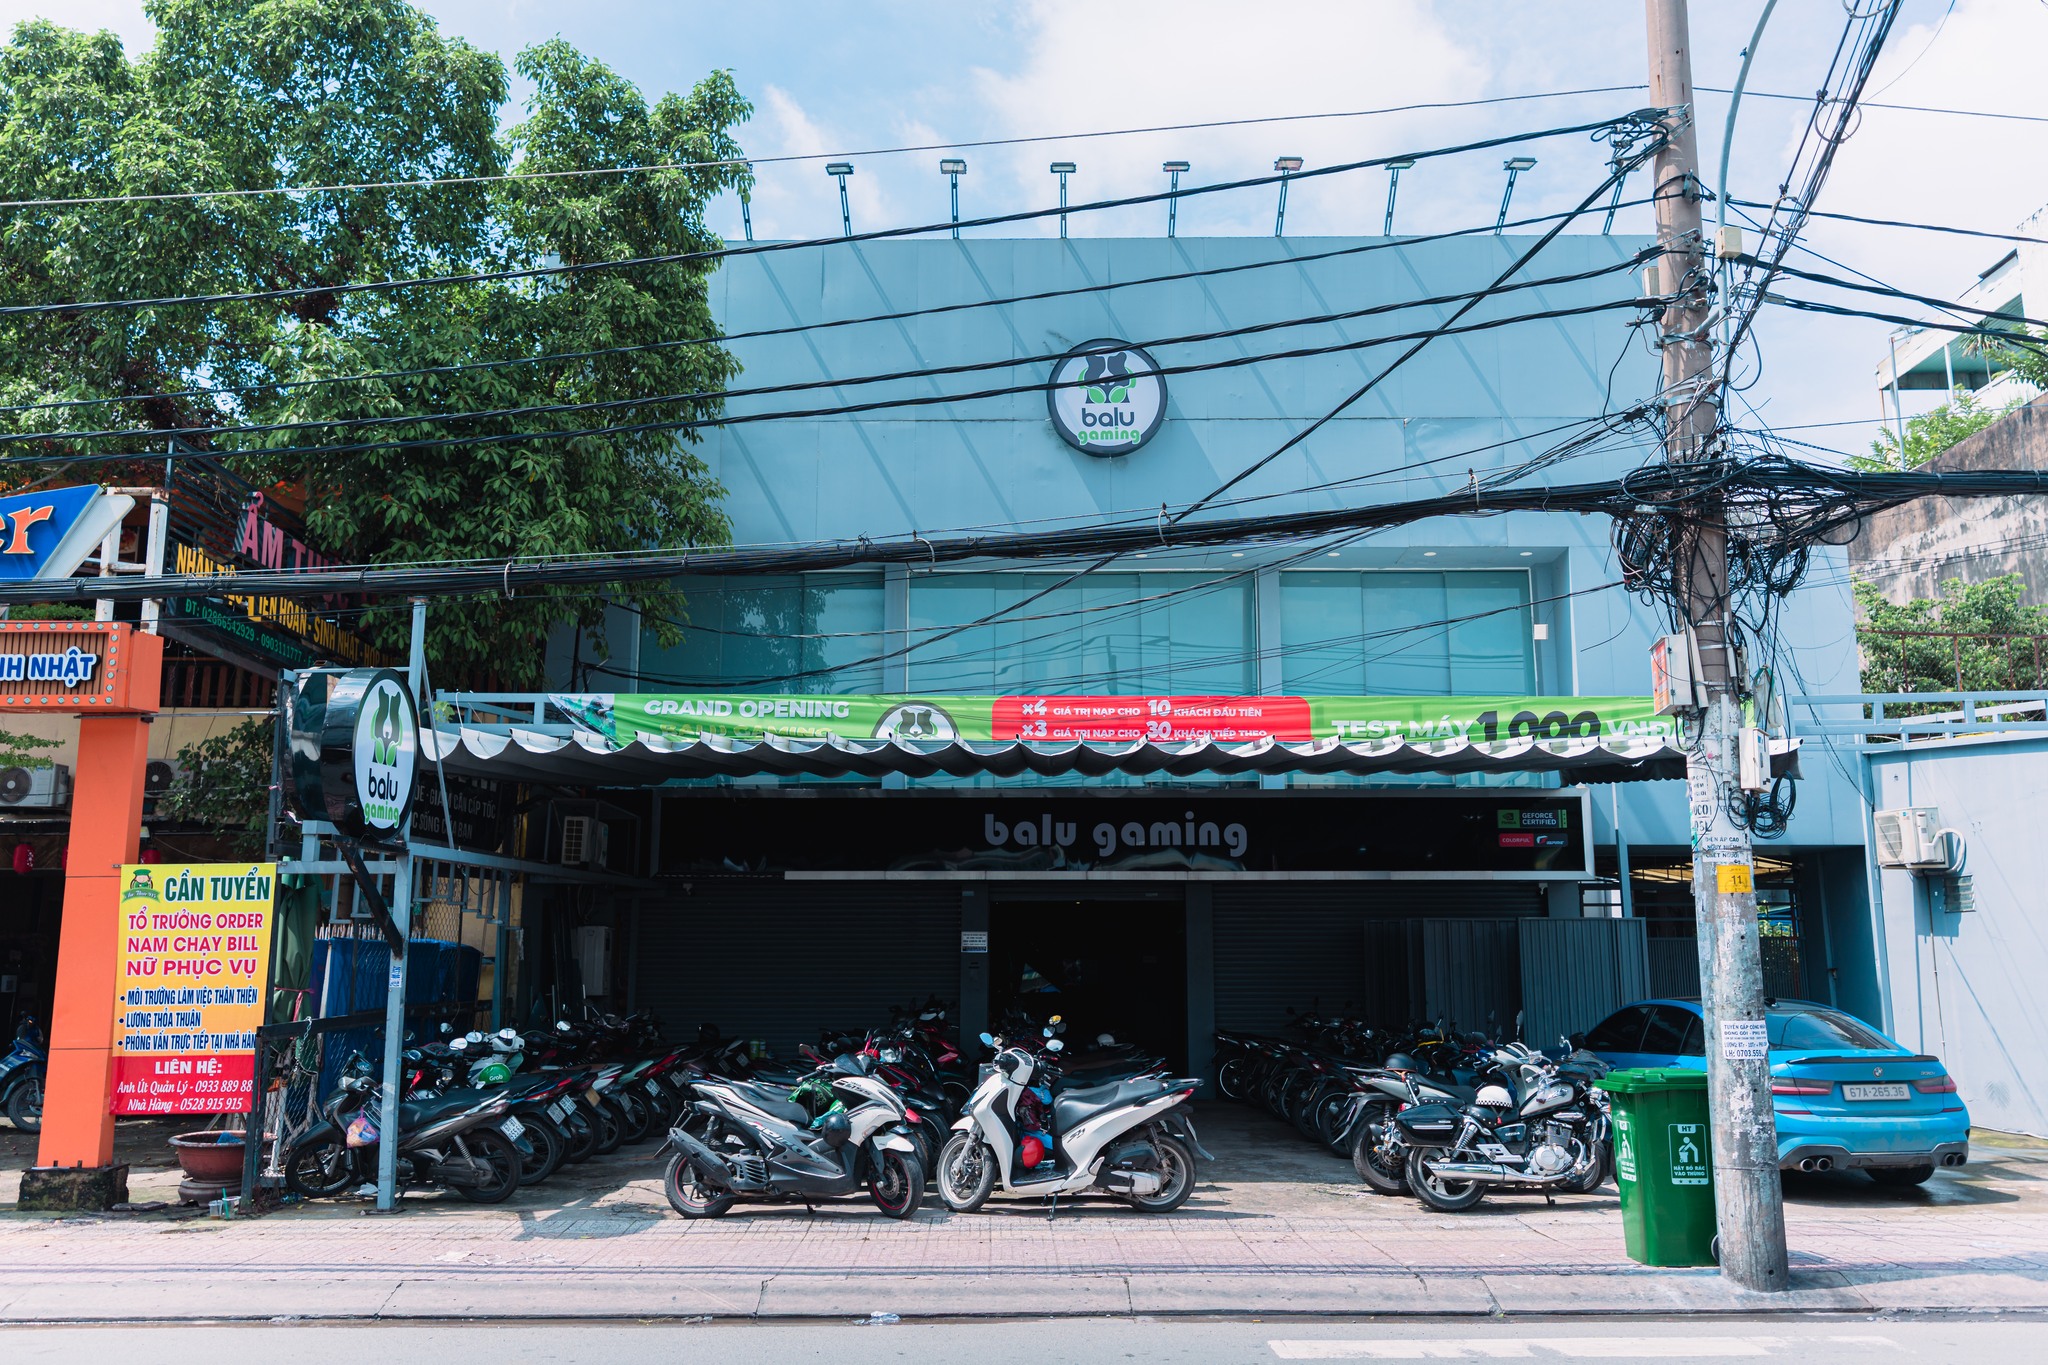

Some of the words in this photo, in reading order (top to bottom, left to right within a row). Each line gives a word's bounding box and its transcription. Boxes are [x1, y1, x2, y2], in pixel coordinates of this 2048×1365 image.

[1081, 407, 1134, 427] balu
[1078, 426, 1140, 444] gaming
[30, 648, 94, 685] NHẬT
[644, 700, 733, 717] GRAND
[739, 701, 849, 718] OPENING
[1053, 706, 1072, 715] GIÁ
[1074, 707, 1090, 717] TRỊ
[1093, 707, 1115, 717] NẠP
[1118, 707, 1140, 716] CHO
[1148, 699, 1171, 716] 10
[1173, 707, 1212, 717] KHÁCH
[1239, 707, 1262, 716] TIÊN
[1053, 727, 1072, 737] GIÁ
[1093, 729, 1115, 738] NẠP
[1118, 729, 1140, 737] CHO
[1146, 720, 1171, 738] 30
[1173, 728, 1212, 738] KHÁCH
[1332, 720, 1401, 738] TEST
[1409, 715, 1474, 738] MÁY
[368, 768, 398, 801] balu
[364, 801, 399, 827] gaming
[985, 814, 1076, 845] balu
[1093, 811, 1247, 857] gaming
[165, 869, 204, 901] CẦN
[211, 866, 270, 900] TUYỂN
[129, 906, 147, 929] TỔ
[152, 908, 211, 929] TRƯỞNG
[216, 913, 263, 929] ORDER
[128, 937, 167, 952] NAM
[173, 936, 222, 956] CHẠY
[228, 936, 258, 951] BILL
[127, 957, 157, 976] NỮ
[163, 959, 222, 979] PHỤC
[229, 959, 256, 978] VỤ
[127, 988, 142, 1005] MÔI
[144, 987, 175, 1005] TRƯỜNG
[177, 987, 194, 1004] LÀM
[196, 987, 212, 1007] VIỆC
[214, 986, 234, 1004] THÂN
[236, 986, 258, 1007] THIỆN
[126, 1011, 151, 1028] LƯƠNG
[153, 1008, 173, 1027] THỎA
[176, 1009, 201, 1030] THUẬN
[125, 1031, 150, 1050] PHỎNG
[153, 1029, 168, 1050] VẤN
[171, 1034, 190, 1053] TRỰC
[192, 1029, 209, 1049] TIẾP
[211, 1033, 222, 1053] TẠI
[224, 1030, 239, 1049] NHÀ
[241, 1030, 256, 1049] HÀN
[155, 1059, 192, 1075] LIÊN
[196, 1058, 222, 1076] HỆ:
[117, 1081, 134, 1093] Anh
[137, 1079, 149, 1093] Út
[150, 1080, 174, 1094] Quản
[176, 1080, 188, 1095] Lý
[195, 1080, 218, 1093] 0933
[220, 1080, 237, 1092] 889
[240, 1080, 253, 1092] 88
[489, 1074, 503, 1082] Grab
[128, 1099, 146, 1111] Nhà
[147, 1099, 173, 1113] Hàng
[180, 1098, 204, 1110] 0528
[205, 1098, 223, 1110] 915
[225, 1097, 243, 1109] 915
